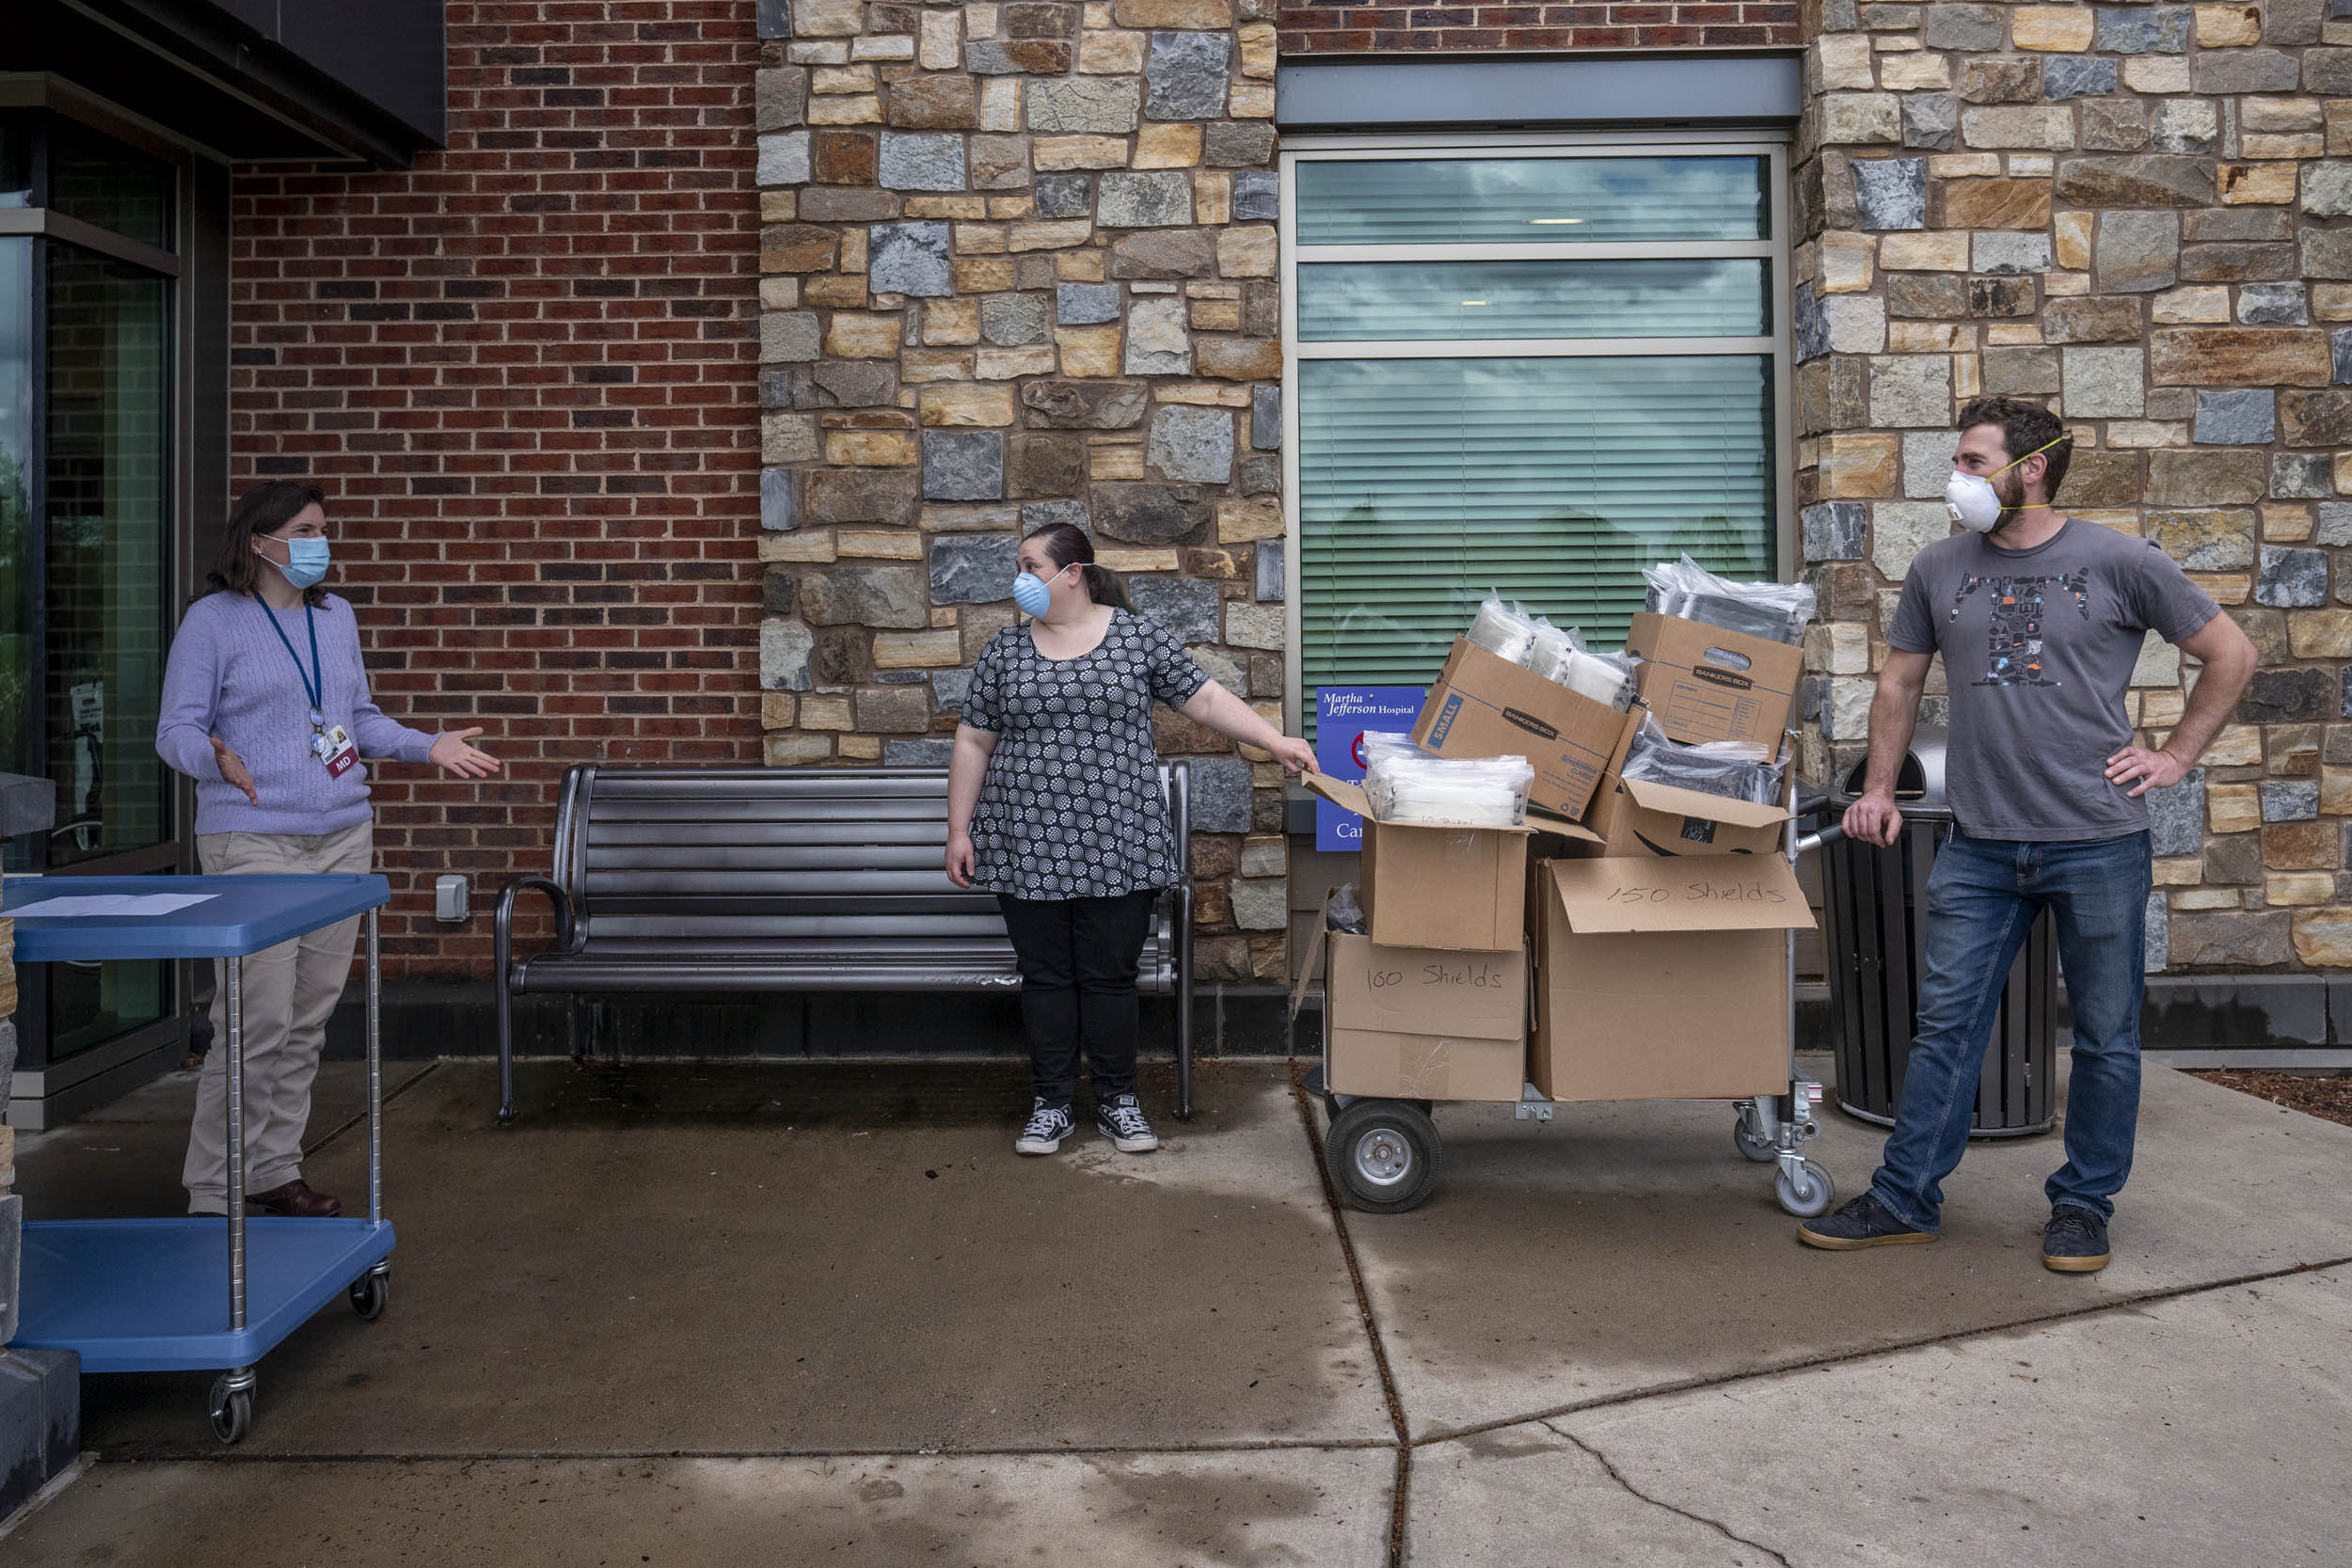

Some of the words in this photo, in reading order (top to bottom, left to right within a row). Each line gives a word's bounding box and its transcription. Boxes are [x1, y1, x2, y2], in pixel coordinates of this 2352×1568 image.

[1732, 678, 1750, 687] BOX
[1323, 692, 1363, 704] Martha
[1326, 702, 1376, 717] Jefferson
[1378, 705, 1415, 716] Hospital
[1434, 703, 1459, 740] SMALL
[1539, 726, 1556, 737] BOX
[335, 755, 351, 772] MD
[1607, 887, 1670, 903] 150
[1687, 881, 1787, 903] Shields
[1422, 963, 1502, 989] Shields
